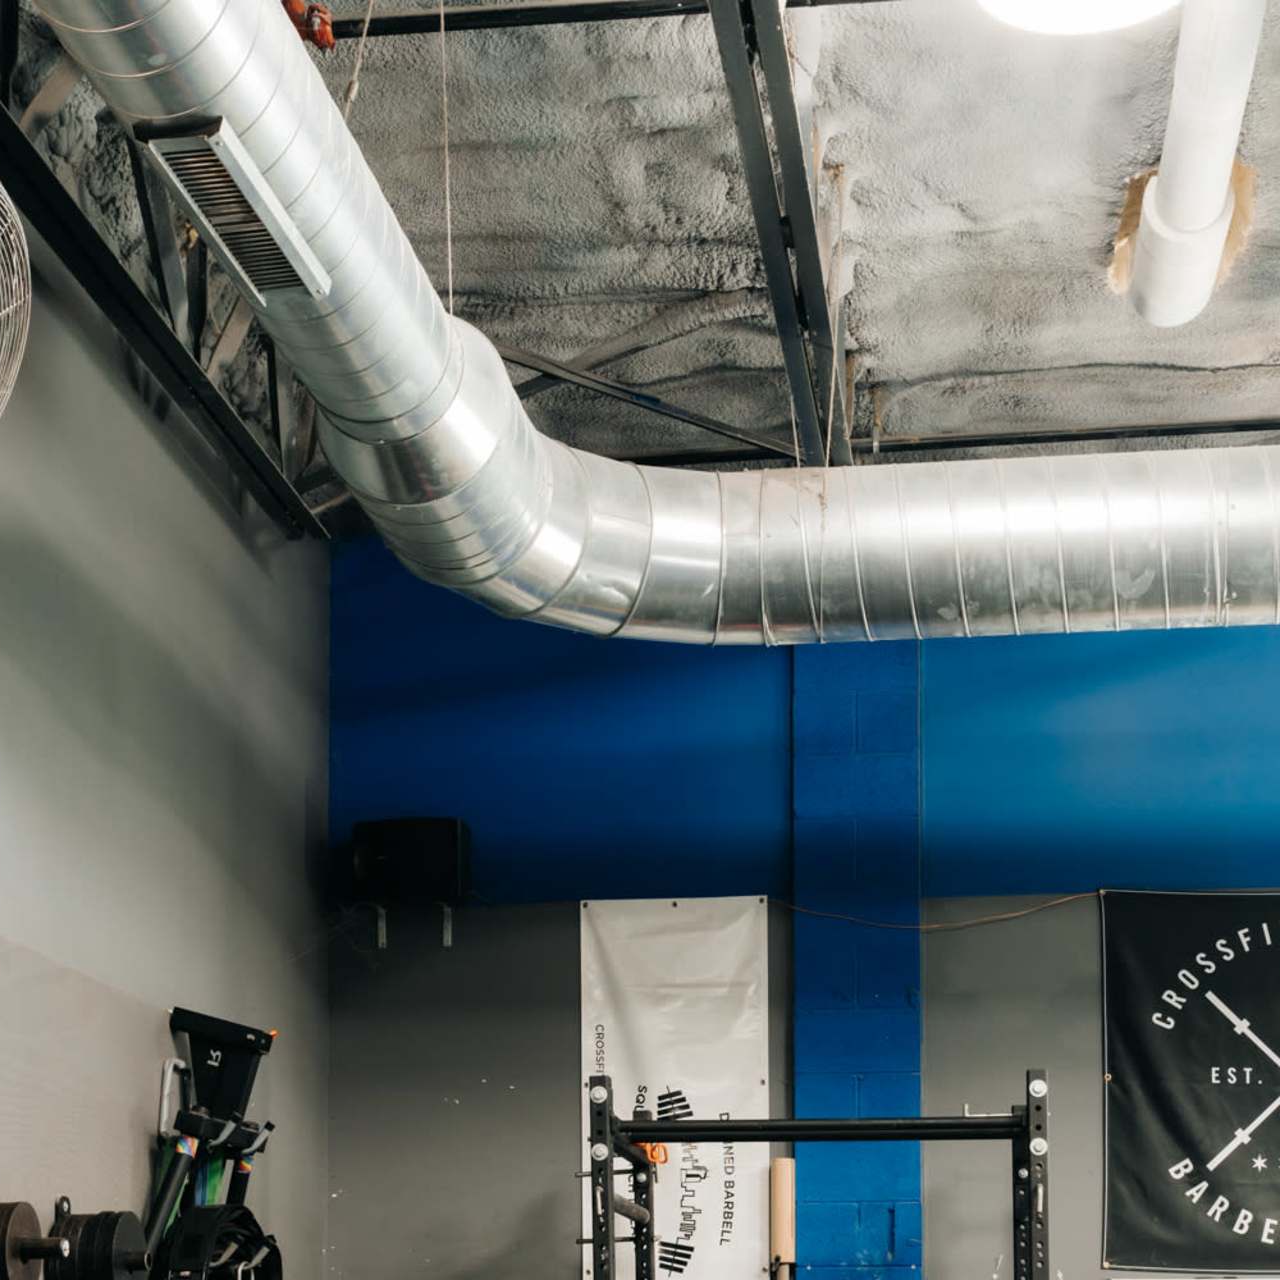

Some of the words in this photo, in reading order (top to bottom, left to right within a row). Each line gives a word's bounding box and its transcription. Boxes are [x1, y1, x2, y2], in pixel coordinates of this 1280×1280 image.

[595, 1024, 605, 1073] CROSSFI
[1211, 1067, 1264, 1085] EST.
[719, 1180, 736, 1246] BARBELL
